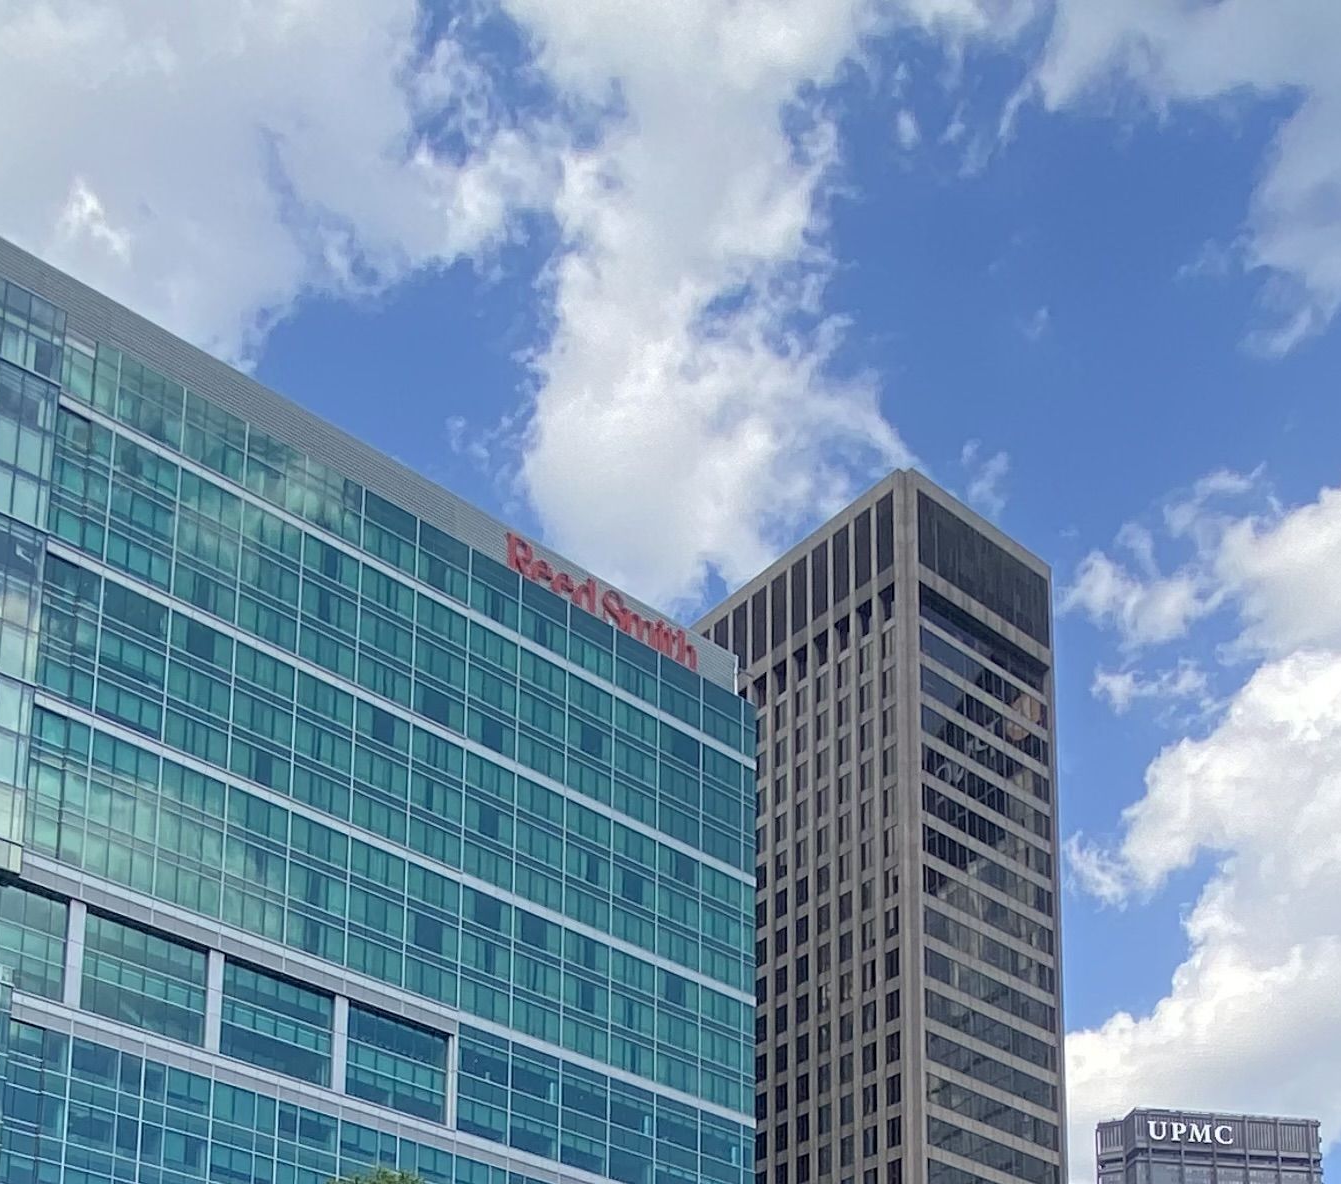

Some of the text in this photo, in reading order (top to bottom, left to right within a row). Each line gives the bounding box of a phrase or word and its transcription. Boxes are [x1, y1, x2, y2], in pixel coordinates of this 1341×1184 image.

[505, 531, 698, 672] Reed Smith
[1147, 1120, 1234, 1145] UPMC
